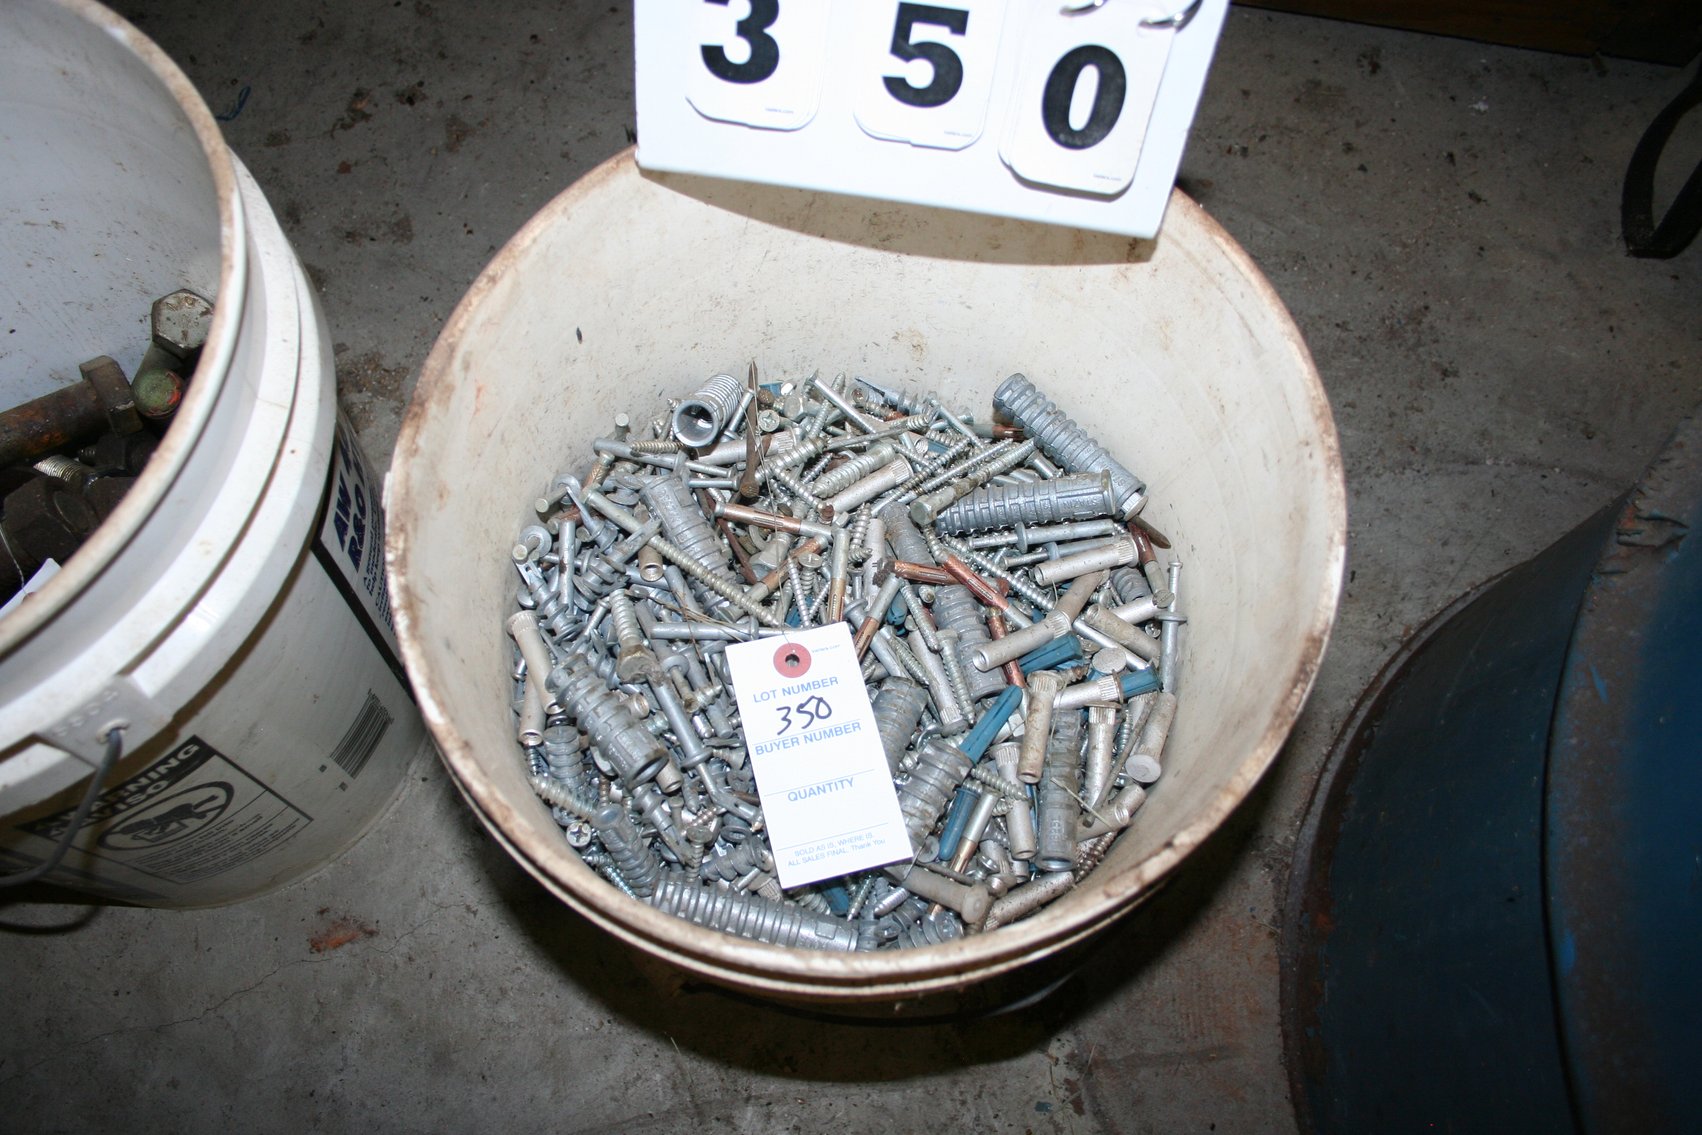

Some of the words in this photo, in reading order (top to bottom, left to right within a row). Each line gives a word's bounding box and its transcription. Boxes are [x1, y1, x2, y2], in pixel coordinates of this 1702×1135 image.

[700, 0, 780, 84] 3
[881, 1, 970, 108] 5
[1040, 44, 1128, 150] 0
[753, 689, 778, 703] LOT
[782, 676, 839, 697] NUMBER
[776, 695, 832, 736] 350
[755, 736, 800, 756] BUYER
[803, 721, 862, 744] NUMBER
[787, 776, 855, 803] QUANTITY
[788, 858, 801, 867] ALL
[802, 851, 826, 864] SALES
[851, 842, 872, 851] Thank
[794, 846, 815, 857] SOLD
[816, 843, 826, 851] AS
[838, 834, 865, 846] WHERE
